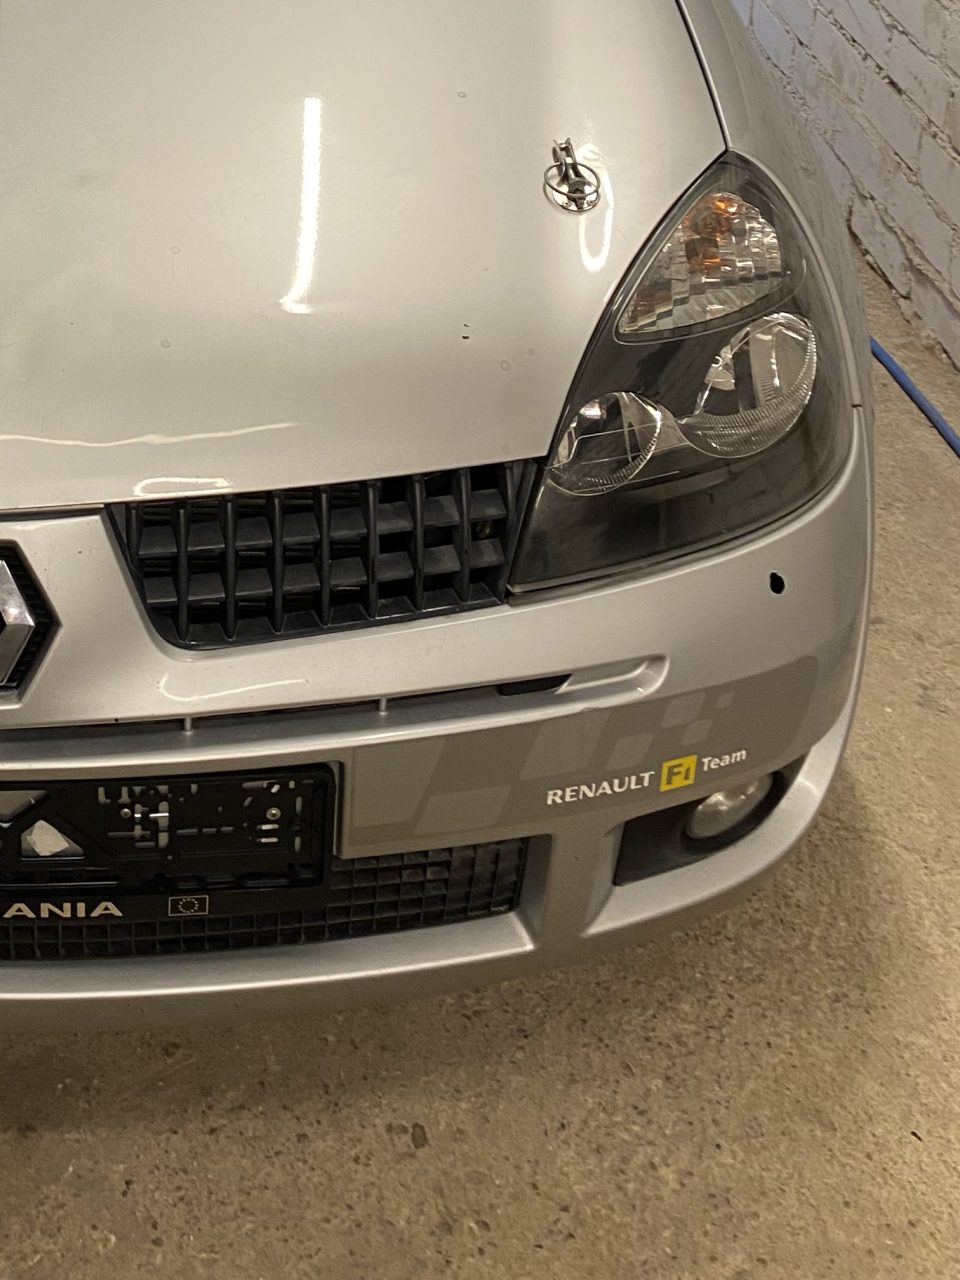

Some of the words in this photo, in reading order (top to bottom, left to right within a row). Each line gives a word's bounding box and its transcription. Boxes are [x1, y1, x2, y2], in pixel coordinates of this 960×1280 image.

[546, 770, 656, 806] RENAULT
[666, 763, 691, 786] F1
[701, 750, 747, 772] Team
